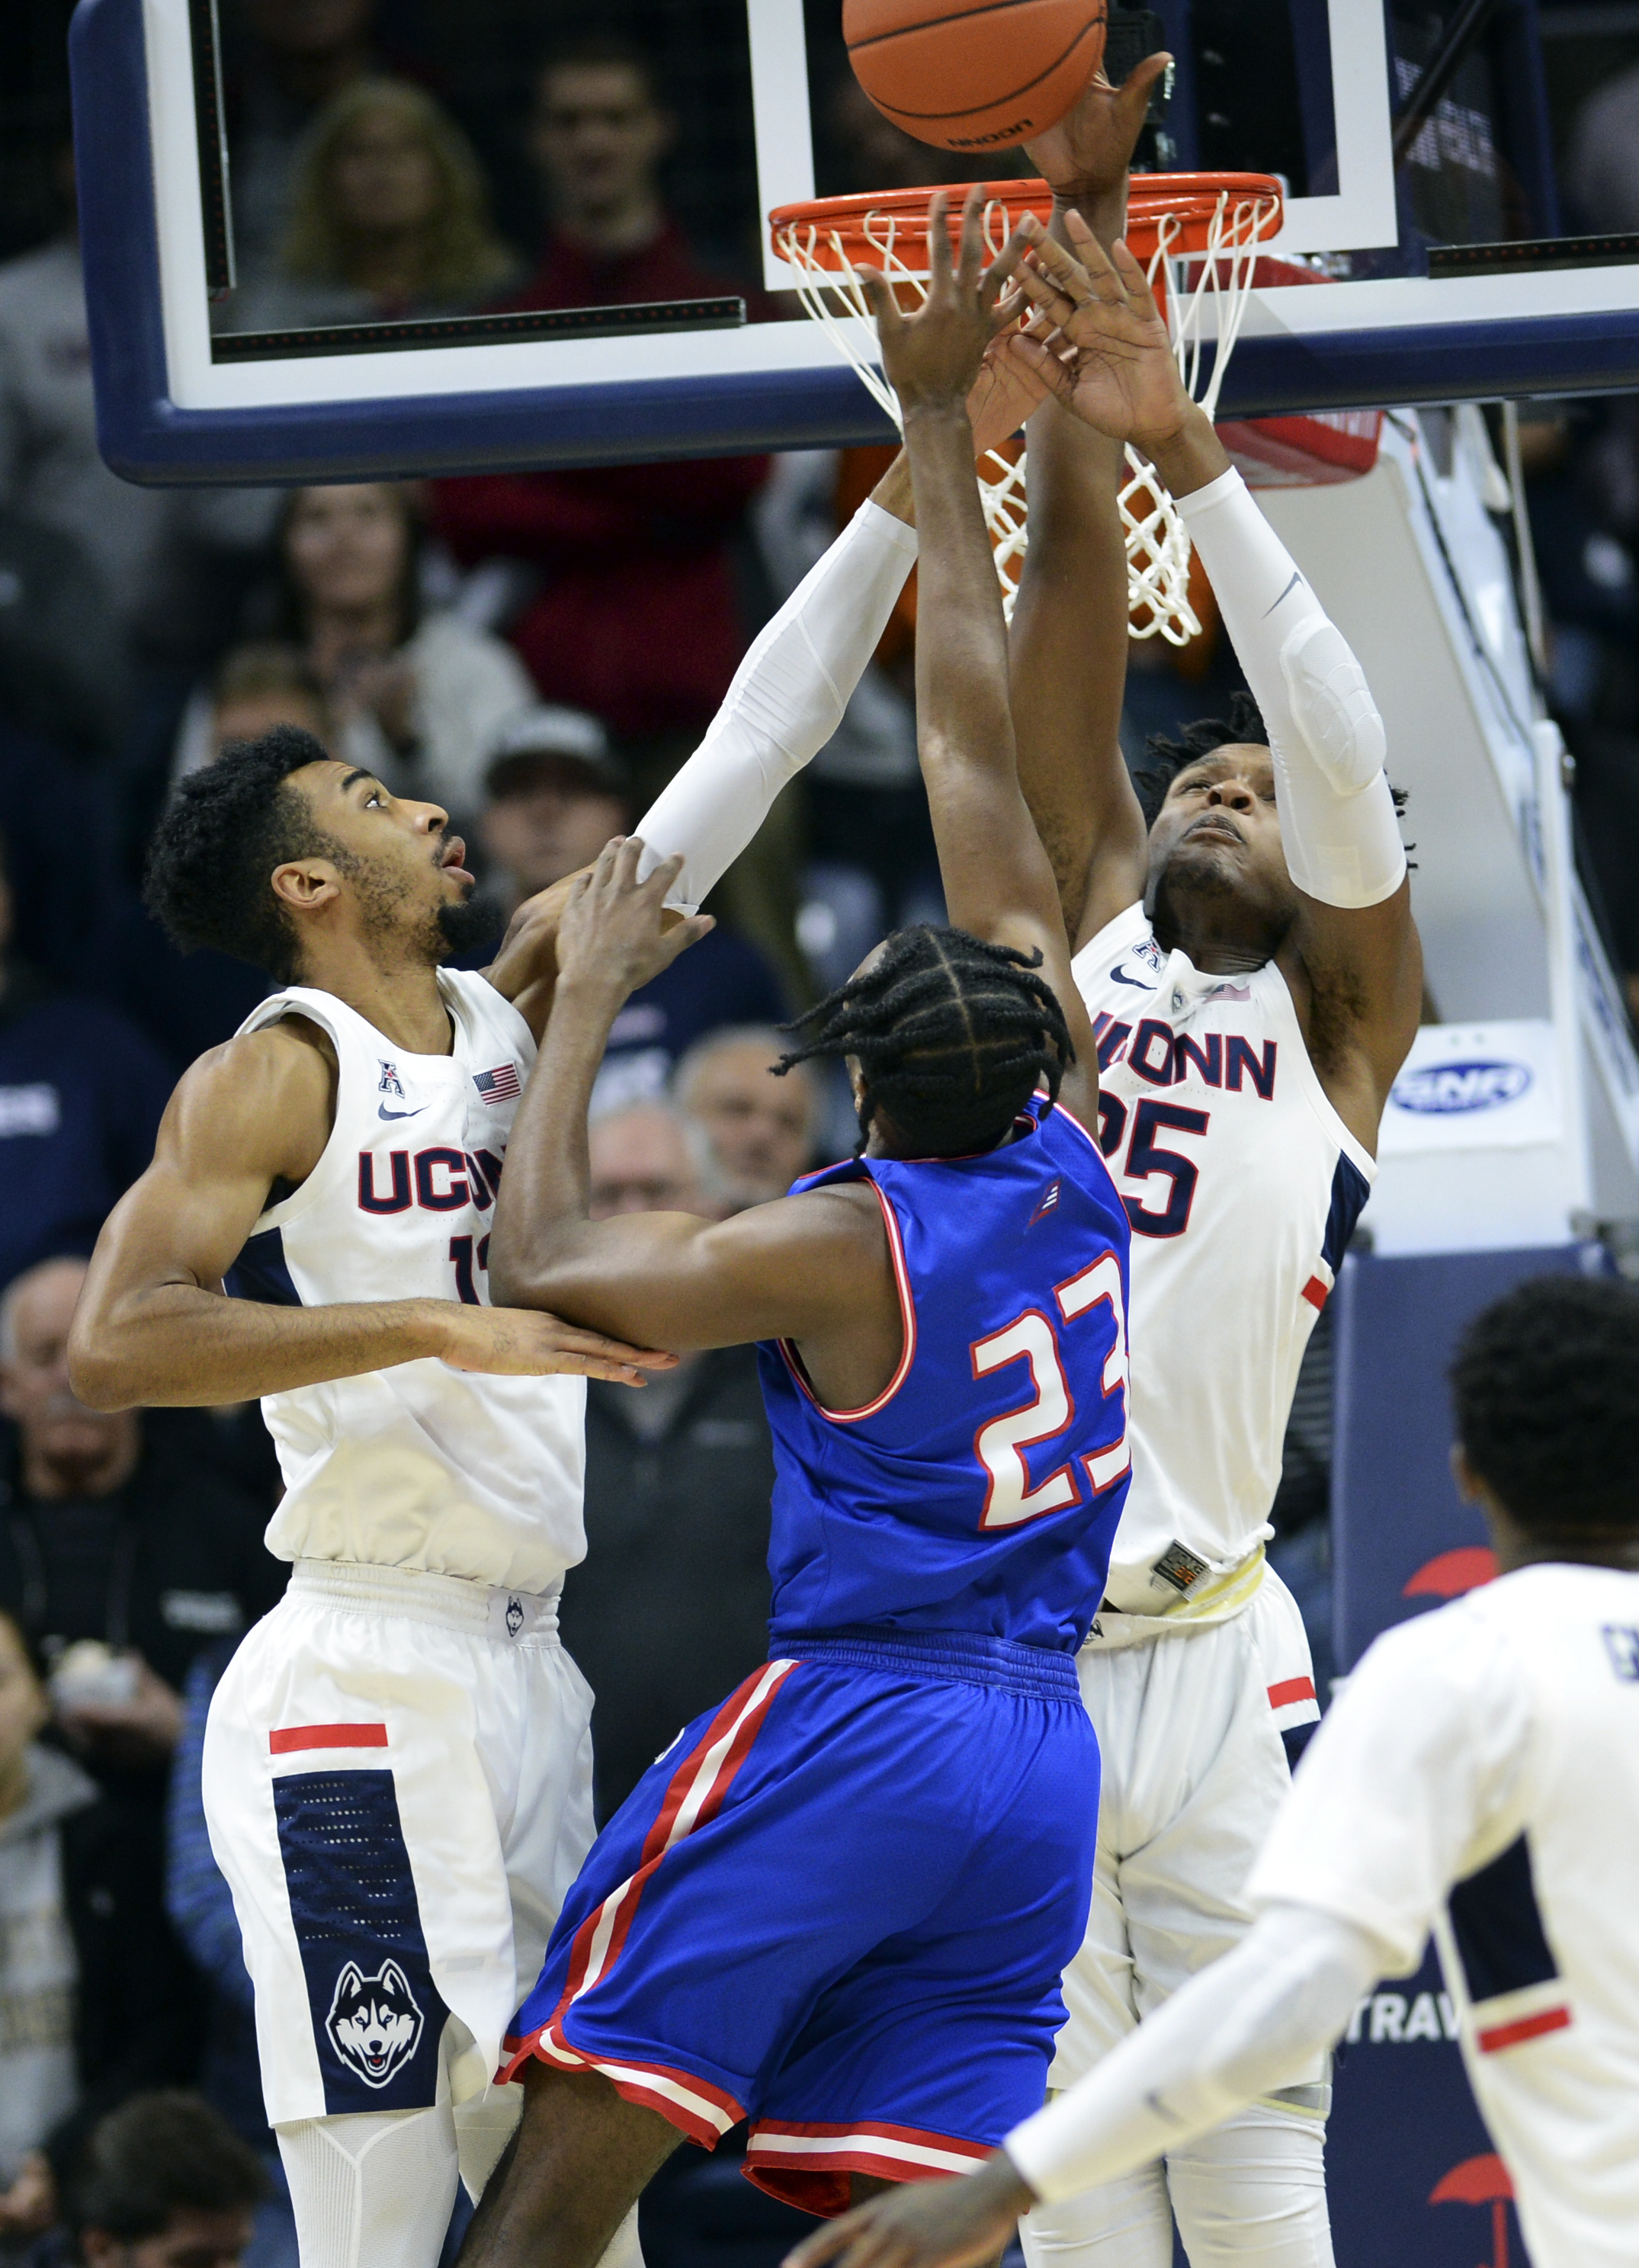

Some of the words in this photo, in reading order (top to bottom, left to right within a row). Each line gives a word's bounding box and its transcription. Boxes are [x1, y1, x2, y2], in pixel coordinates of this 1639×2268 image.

[1092, 1010, 1278, 1102] CONN
[449, 1232, 492, 1306] 1
[969, 1249, 1133, 1532] 23
